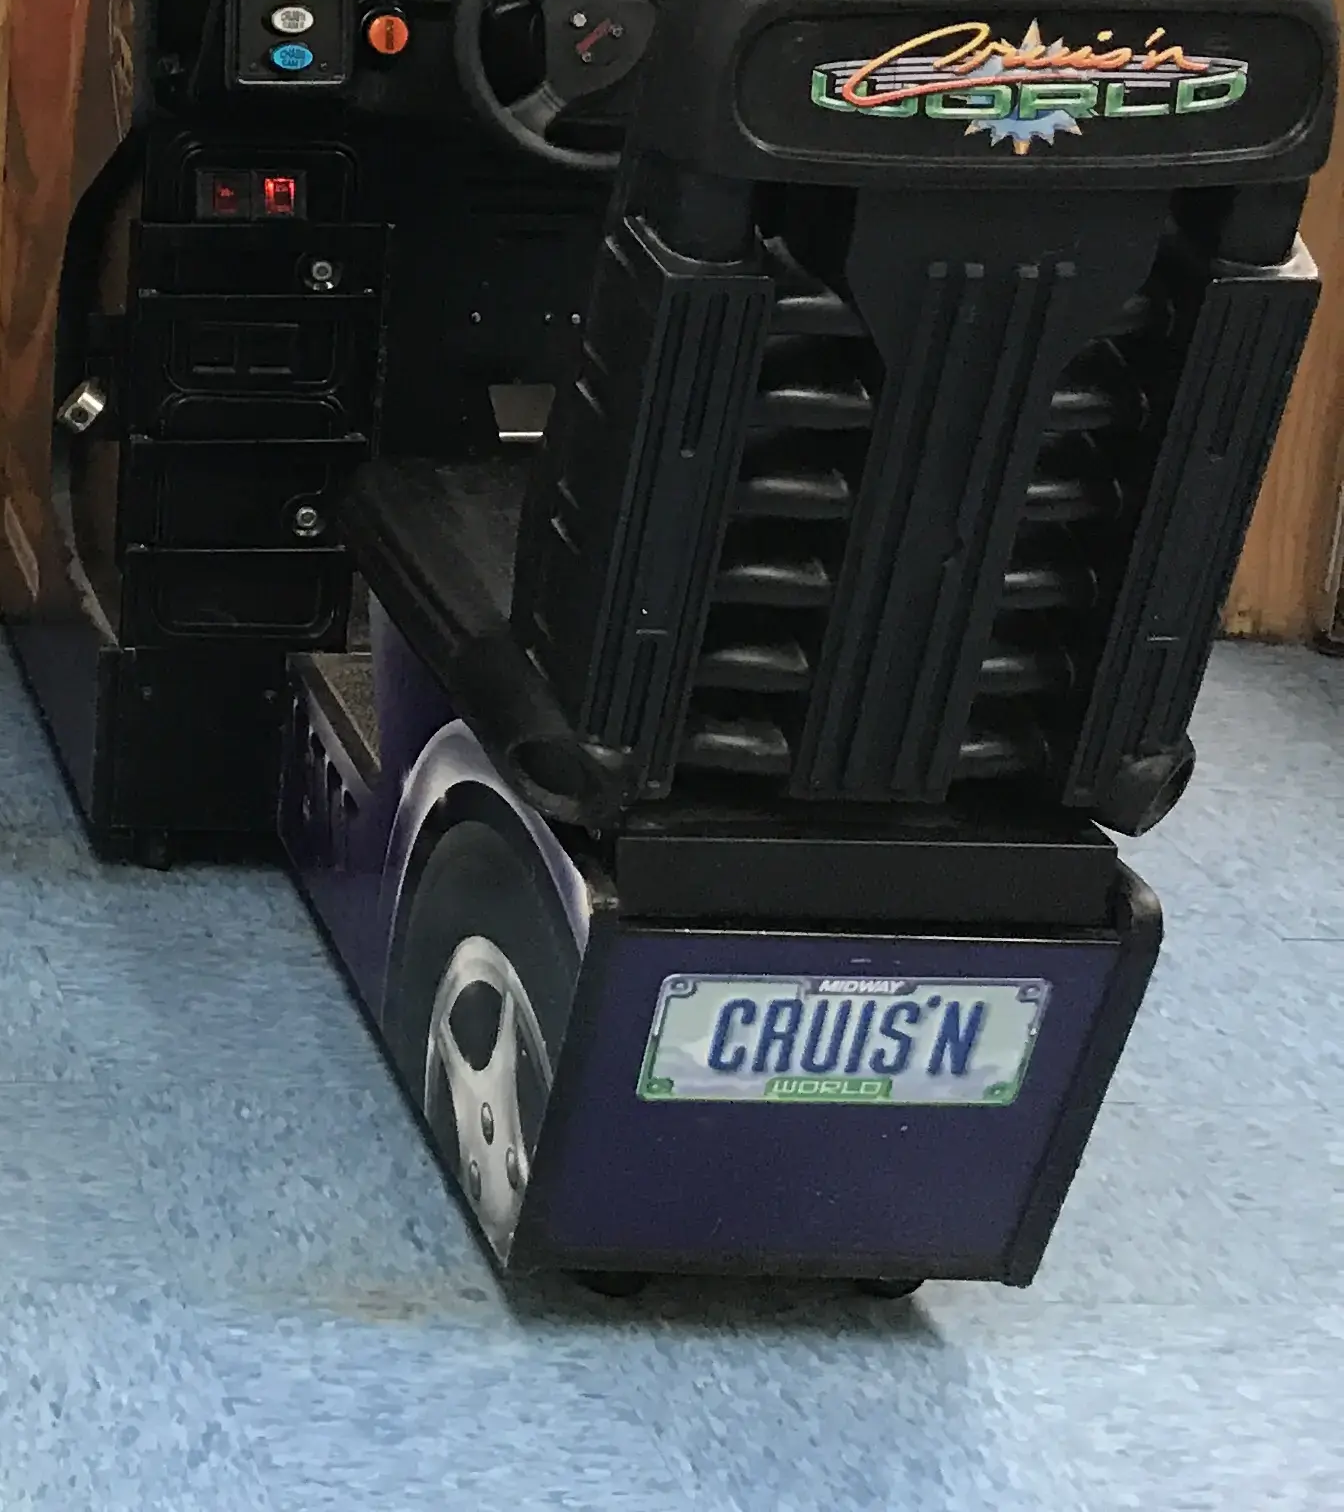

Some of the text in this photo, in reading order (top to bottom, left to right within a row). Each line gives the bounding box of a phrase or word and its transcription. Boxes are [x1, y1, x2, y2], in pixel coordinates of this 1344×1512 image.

[842, 21, 1209, 107] Cruis'n
[812, 69, 1249, 118] WORLD
[818, 979, 905, 994] MIDWAY
[708, 995, 985, 1076] CRUIS'N
[771, 1080, 884, 1096] WORLD
